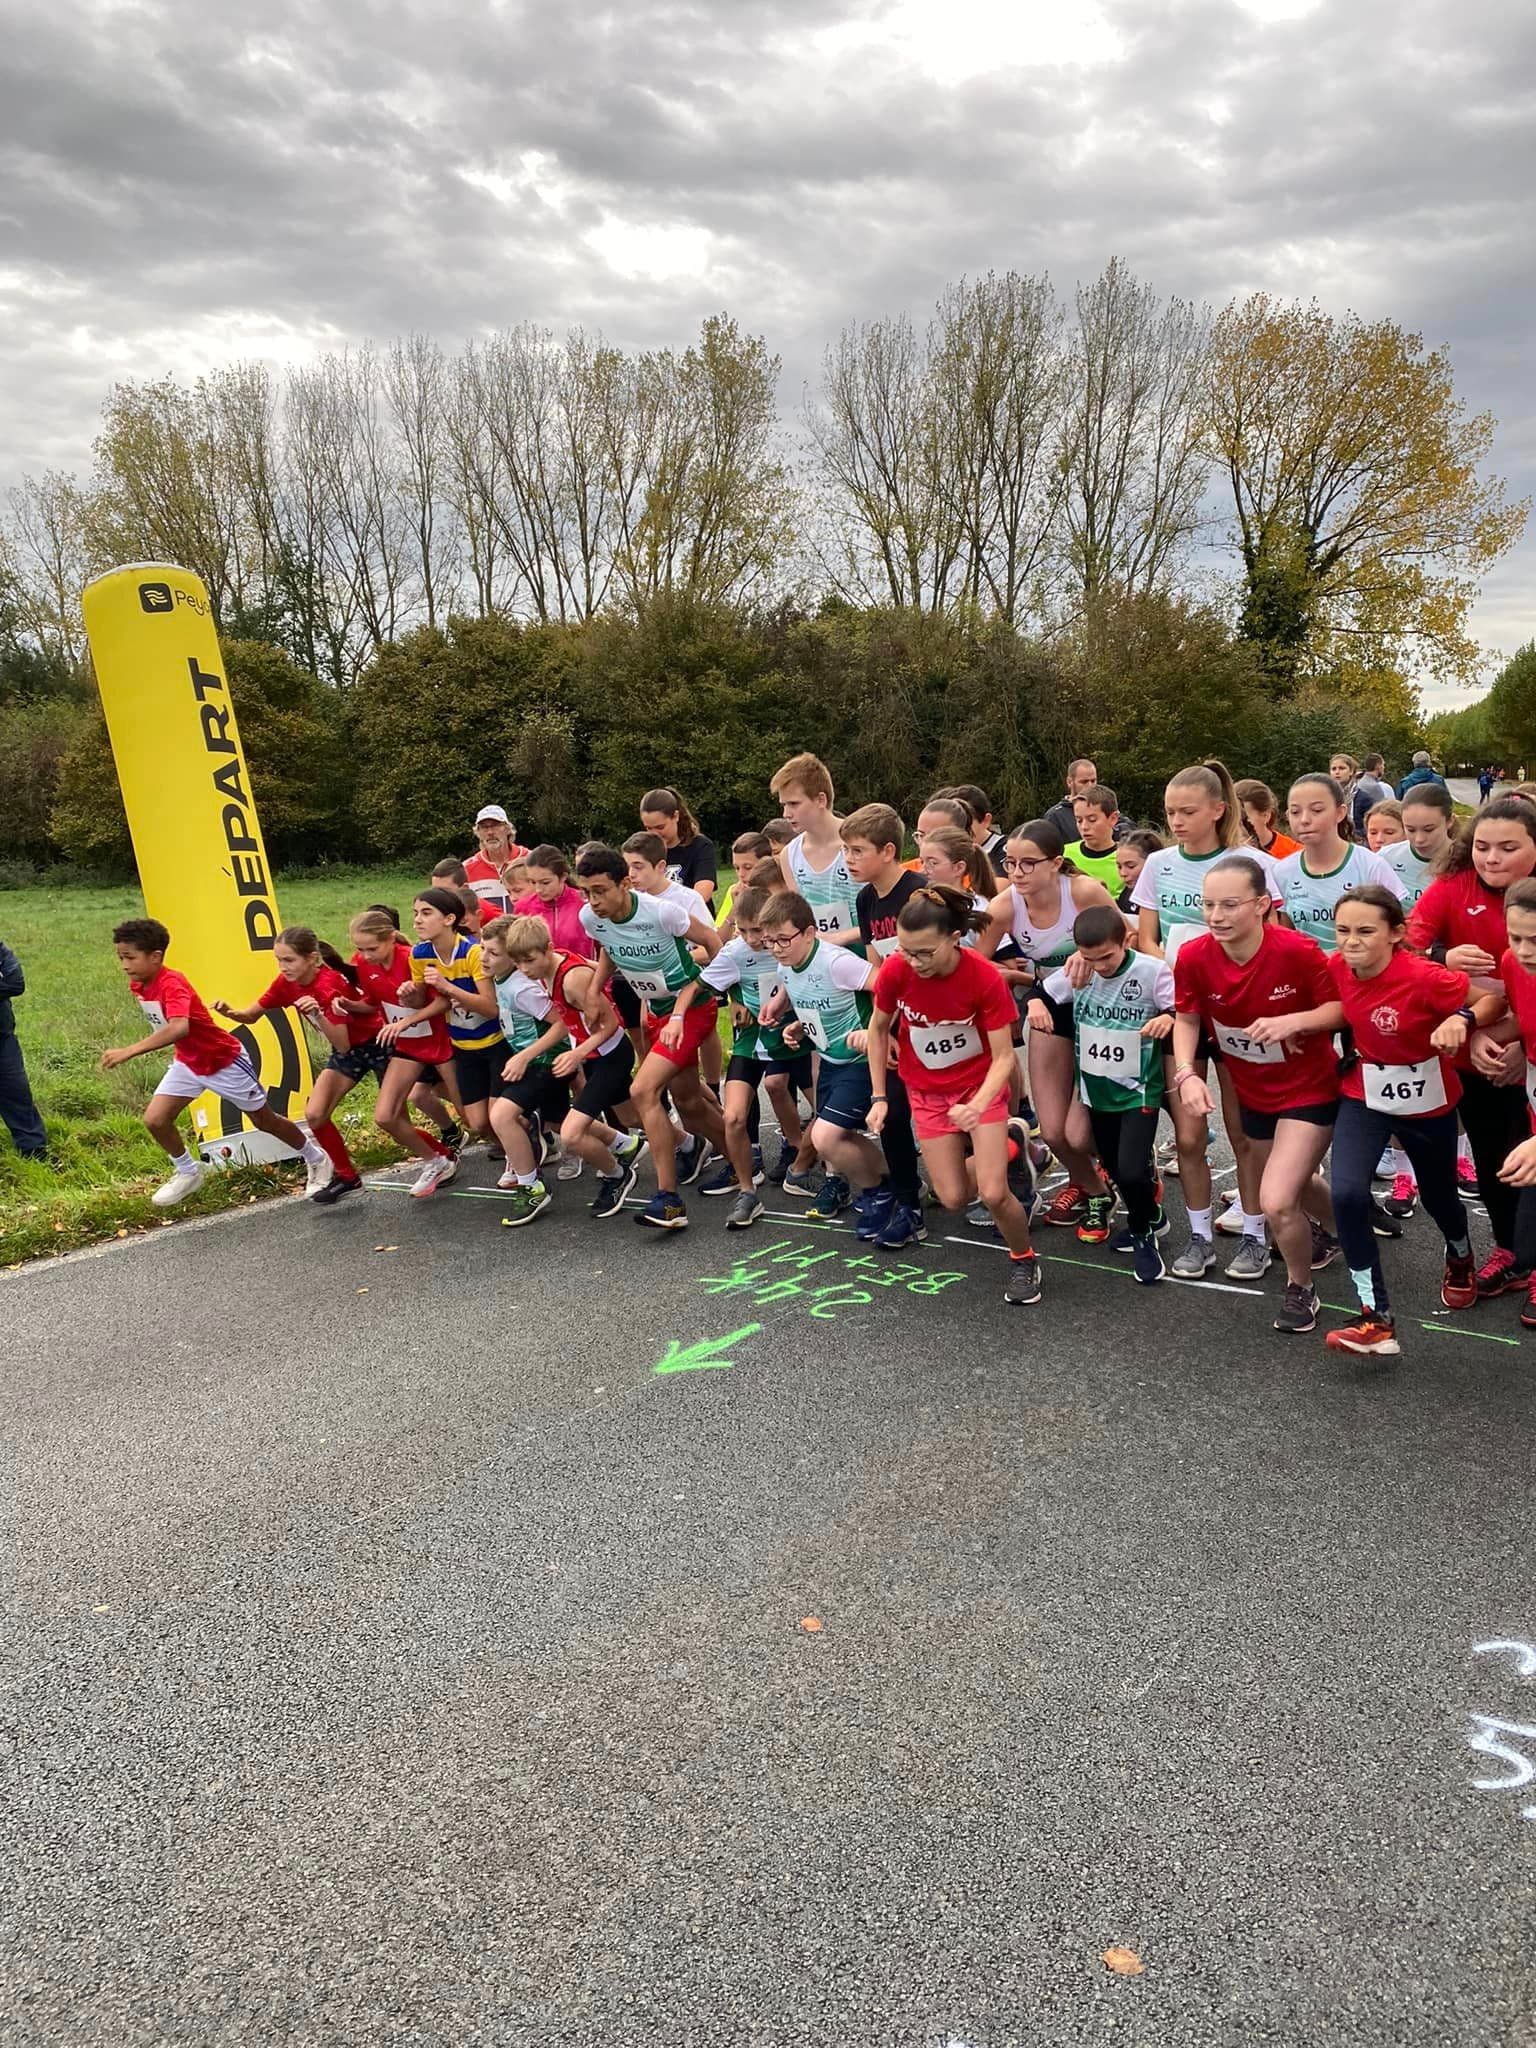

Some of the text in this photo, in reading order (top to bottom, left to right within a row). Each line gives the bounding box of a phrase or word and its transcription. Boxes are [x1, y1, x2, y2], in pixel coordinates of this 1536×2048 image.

[187, 657, 278, 953] DÉPART
[816, 916, 840, 932] 54
[619, 943, 661, 957] DOUCHY
[1096, 1006, 1145, 1021] DOUCHY
[801, 1022, 817, 1036] 50
[924, 1033, 967, 1057] 485
[1088, 1043, 1125, 1063] 449
[1226, 1036, 1266, 1055] 471
[1381, 1080, 1426, 1100] 467
